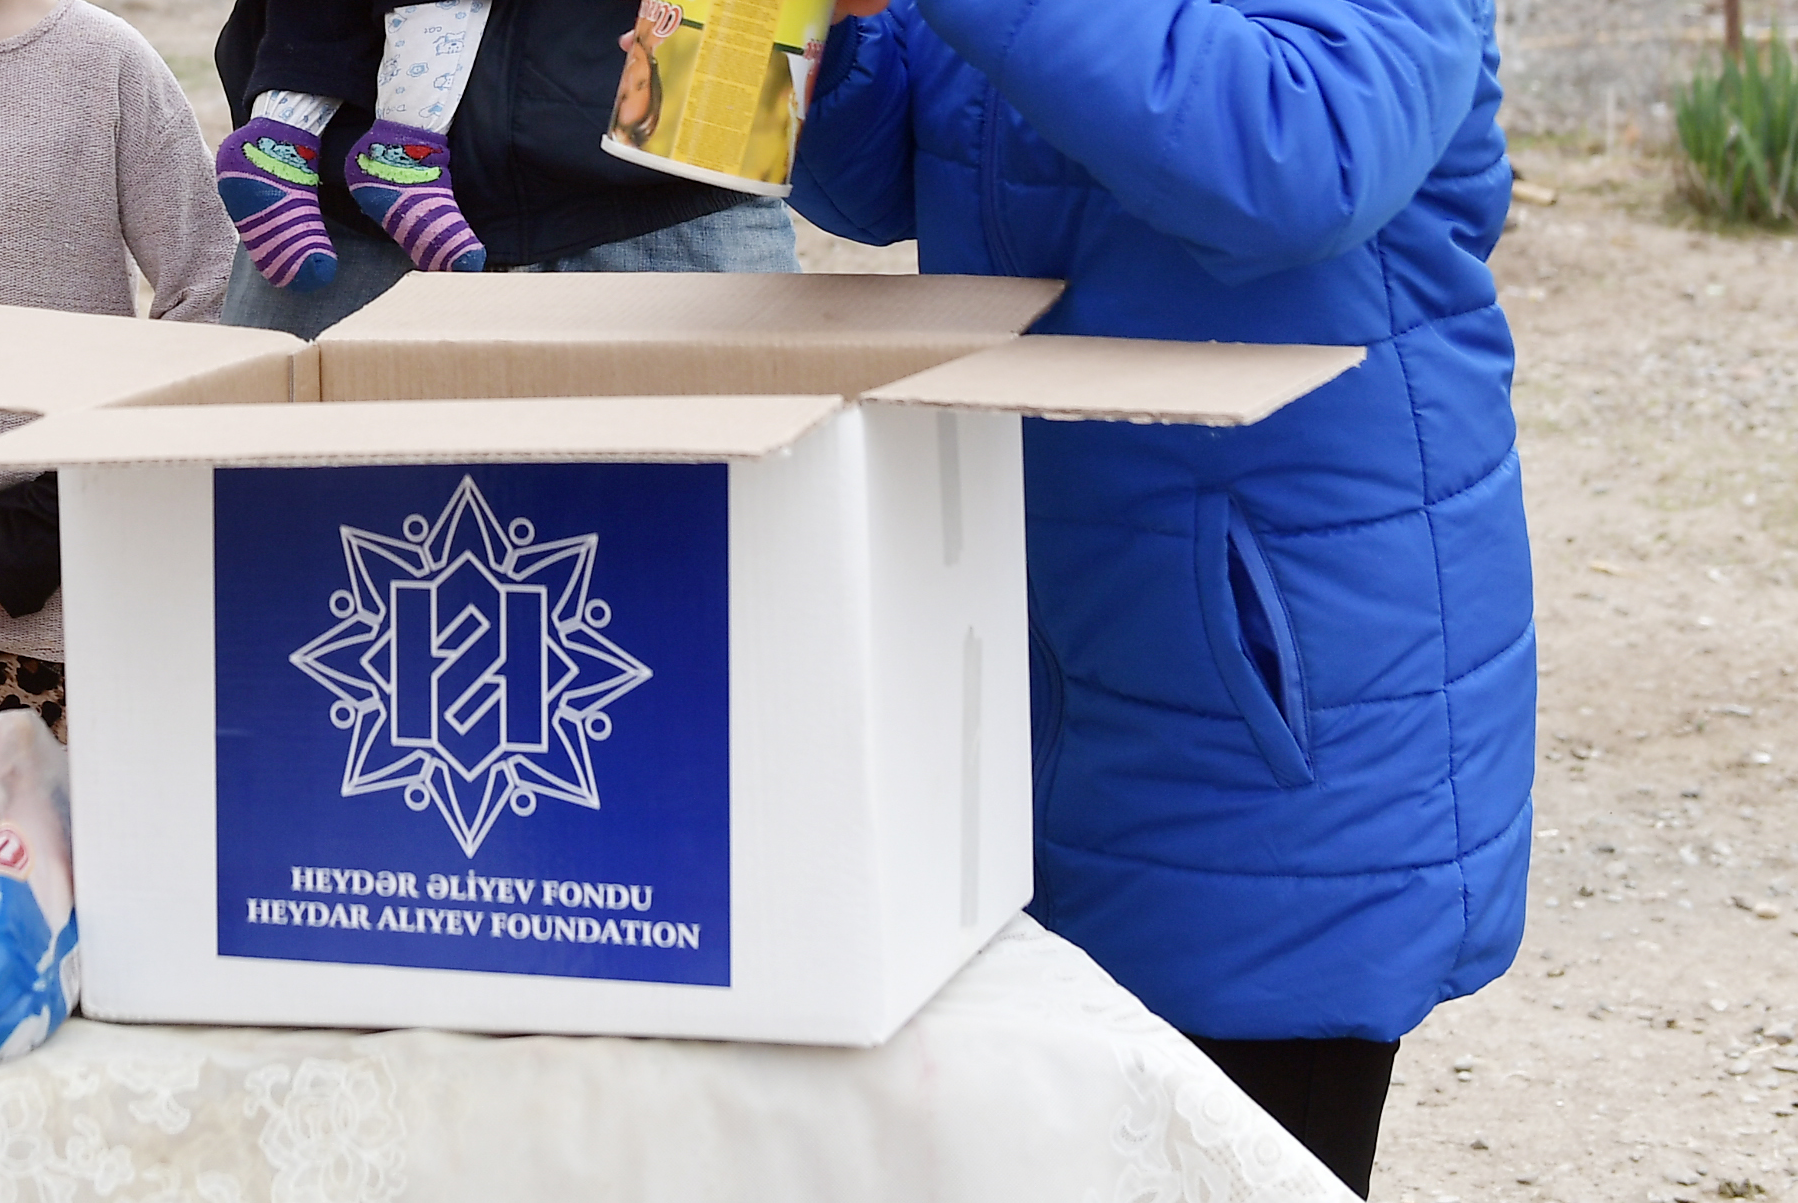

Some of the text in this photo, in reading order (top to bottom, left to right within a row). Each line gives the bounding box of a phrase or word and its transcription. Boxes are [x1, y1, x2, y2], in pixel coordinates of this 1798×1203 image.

[423, 26, 443, 35] cat
[291, 865, 653, 912] HEYDƏR ƏLİYEV FONDU
[247, 897, 701, 950] HEYDAR ALIYEV FOUNDATION
